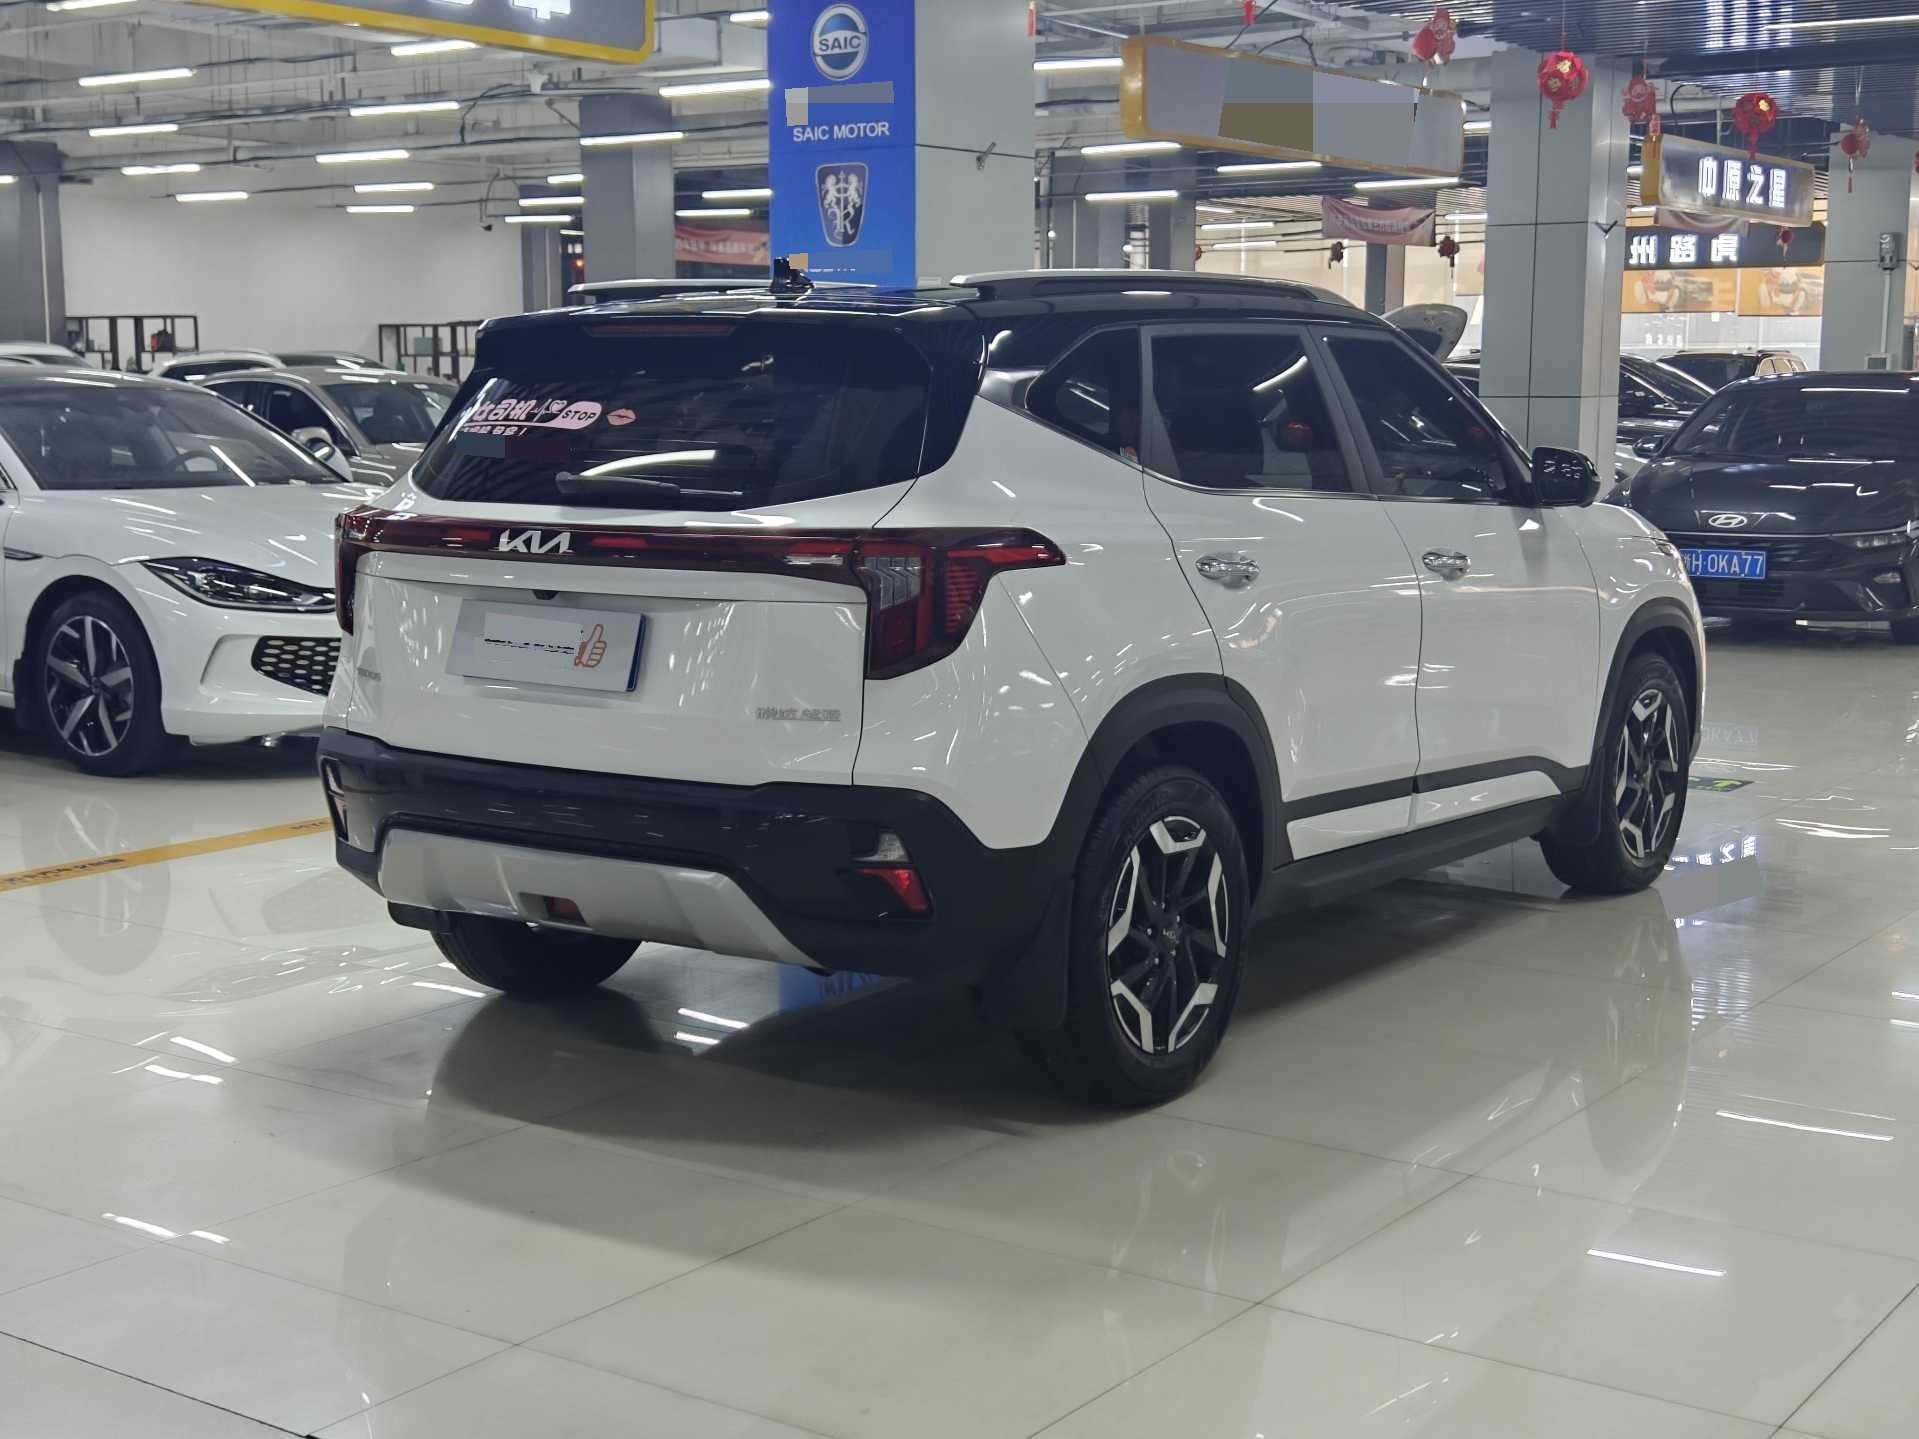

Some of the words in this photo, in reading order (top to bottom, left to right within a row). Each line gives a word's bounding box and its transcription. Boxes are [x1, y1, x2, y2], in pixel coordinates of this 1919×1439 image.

[818, 35, 861, 52] SAIC
[793, 126, 829, 142] SAIC
[833, 121, 890, 139] MOTOR
[1699, 156, 1786, 209] 中原之星
[562, 408, 597, 421] STOP
[499, 528, 571, 554] KIA
